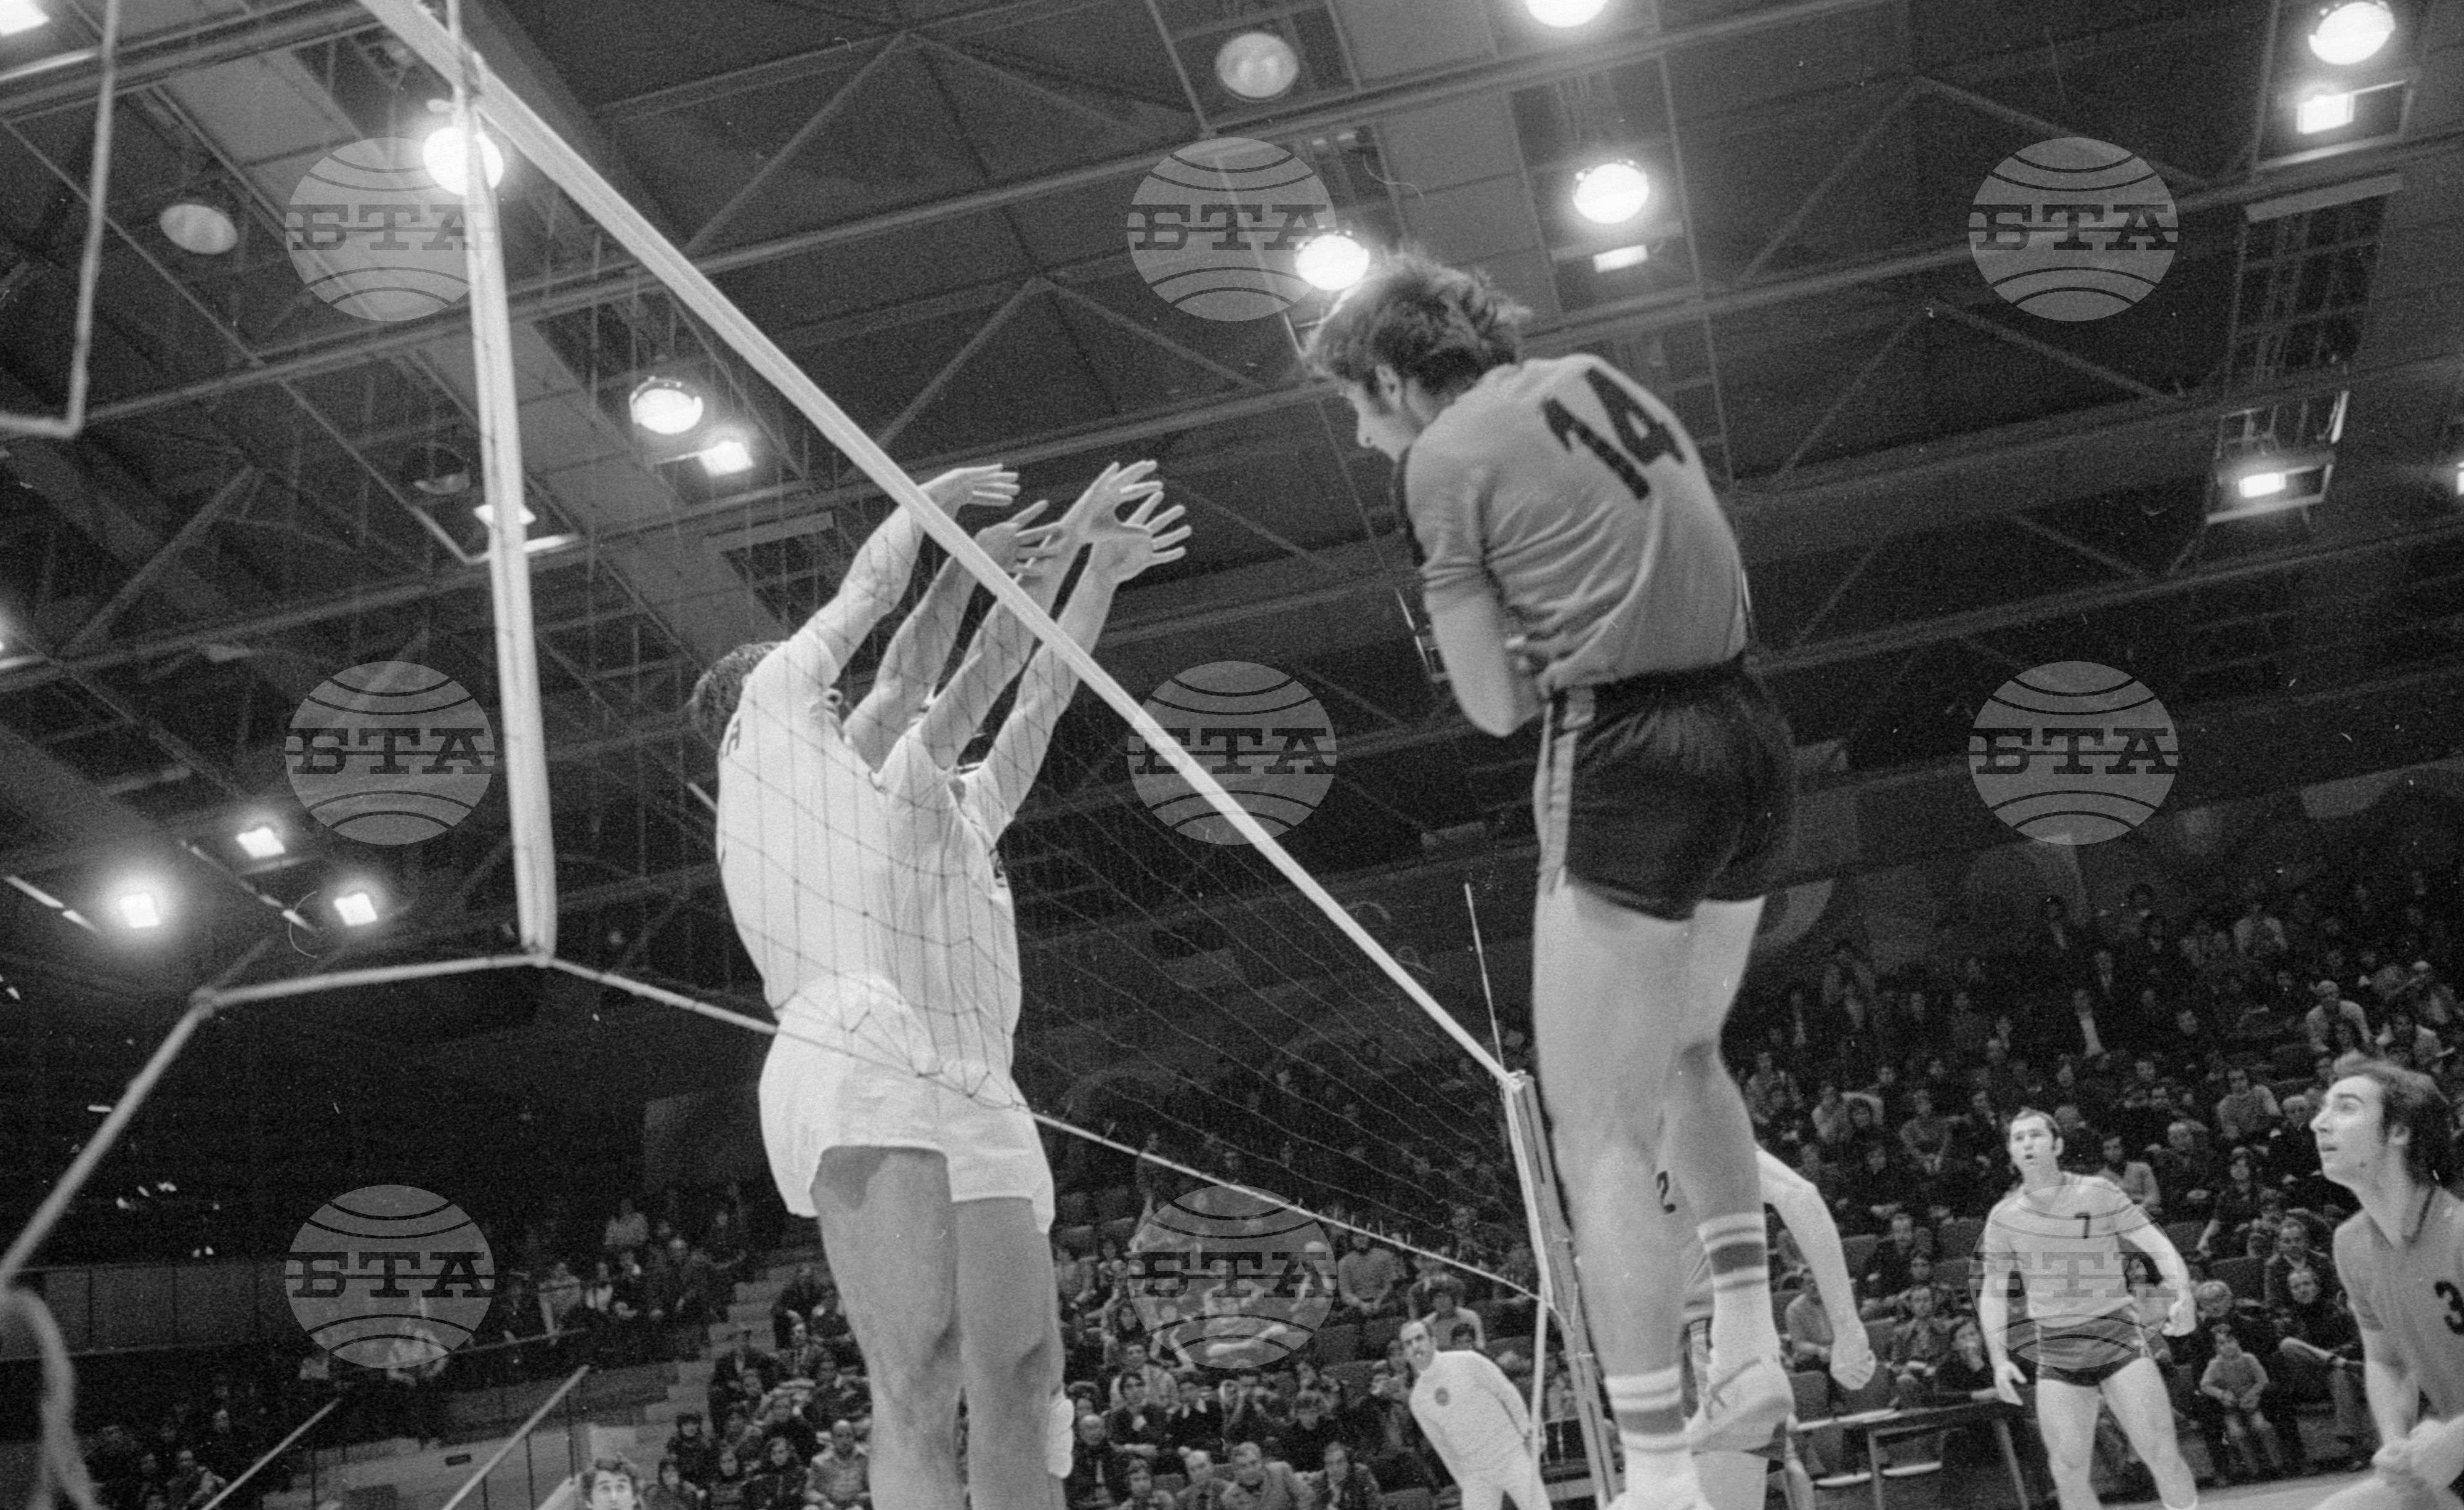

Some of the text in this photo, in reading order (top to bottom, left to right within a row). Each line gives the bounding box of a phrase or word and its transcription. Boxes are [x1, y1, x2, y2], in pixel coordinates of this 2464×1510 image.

[1542, 368, 1686, 500] 14
[2075, 1212, 2091, 1239] 7
[2434, 1281, 2464, 1334] 3
